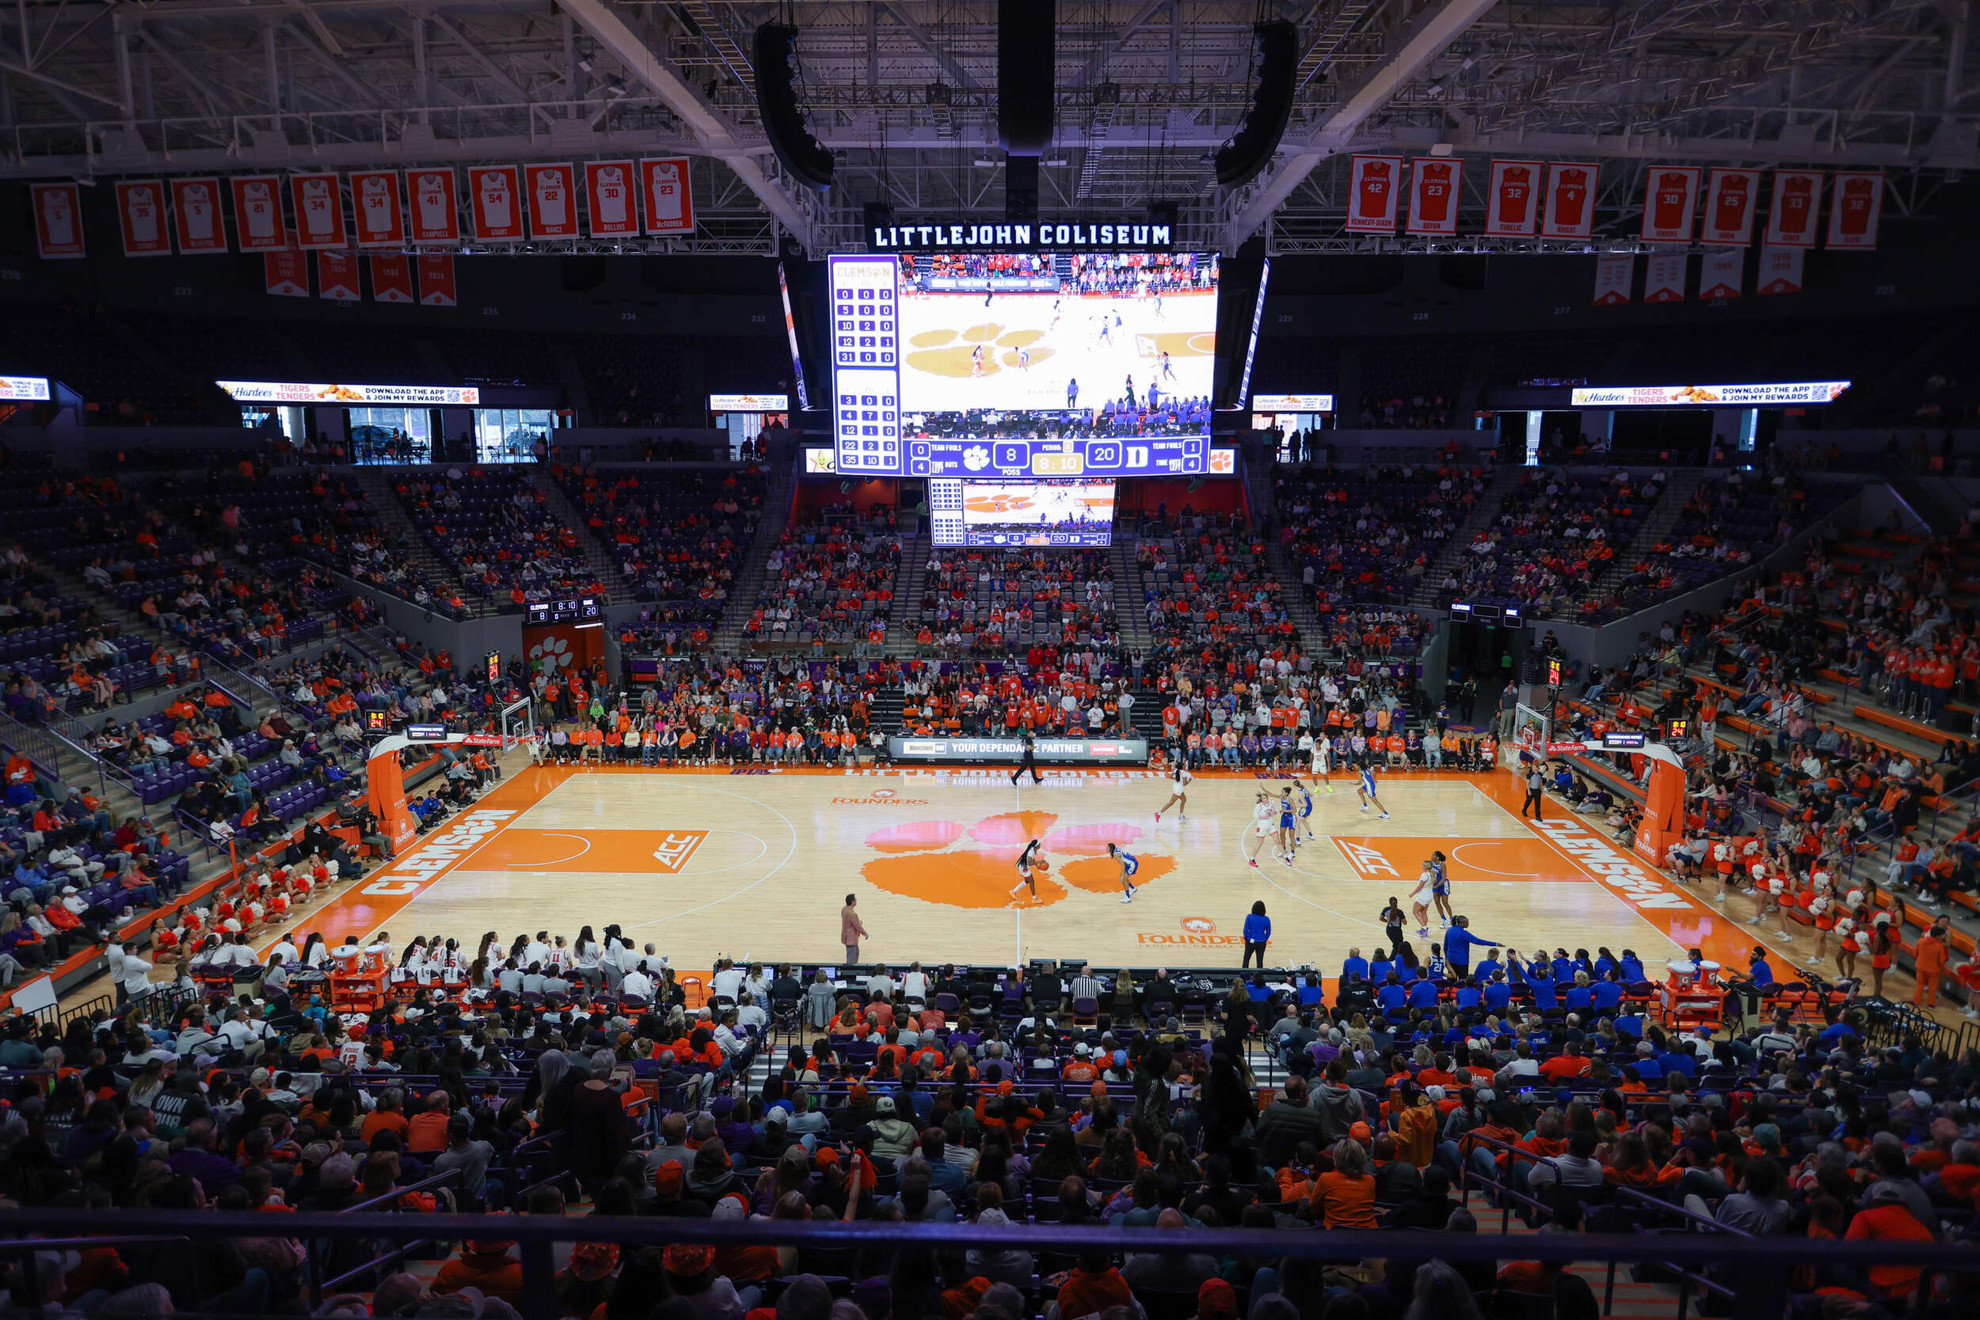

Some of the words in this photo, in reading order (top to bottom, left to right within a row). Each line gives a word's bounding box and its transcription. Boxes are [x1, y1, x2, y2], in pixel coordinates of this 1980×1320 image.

[605, 188, 619, 198] 30
[660, 185, 673, 195] 23
[1367, 183, 1383, 193] 42
[1428, 186, 1442, 196] 23
[1507, 188, 1522, 198] 32
[426, 195, 438, 205] 41
[488, 193, 501, 203] 54
[545, 191, 558, 200] 22
[1566, 190, 1575, 200] 4
[1663, 194, 1679, 205] 30
[311, 200, 325, 211] 34
[369, 198, 383, 208] 34
[1723, 196, 1738, 207] 25
[603, 223, 626, 231] ROLLINS
[874, 225, 1031, 246] LITTLEJOHN
[1040, 225, 1170, 245] COLISEUM
[842, 291, 848, 299] 0
[863, 291, 870, 299] 0
[883, 291, 889, 299] 0
[843, 306, 849, 314] 5
[864, 306, 870, 315] 0
[883, 307, 889, 315] 0
[842, 322, 852, 330] 10
[864, 322, 870, 330] 2
[884, 322, 890, 330] 0
[843, 338, 852, 346] 12
[865, 338, 871, 346] 2
[885, 339, 890, 347] 1
[842, 353, 853, 361] 31
[865, 353, 871, 361] 0
[884, 354, 891, 362] 0
[846, 396, 852, 404] 3
[866, 397, 872, 405] 0
[885, 397, 892, 405] 0
[917, 446, 924, 455] 0
[1190, 443, 1196, 452] 1
[1006, 449, 1017, 461] 8
[1094, 448, 1114, 461] 20
[917, 462, 924, 471] 4
[1188, 460, 1195, 468] 4
[558, 601, 576, 610] 8:10
[540, 612, 545, 620] 8
[586, 607, 596, 615] 20
[489, 664, 499, 680] 24
[1549, 669, 1559, 685] 24
[370, 719, 381, 727] 24
[1671, 728, 1684, 736] 24
[952, 743, 978, 752] YOUR
[979, 743, 1040, 753] DEPENDAE
[1041, 744, 1083, 753] PARTNER
[845, 769, 1031, 778] LITTLEJOHN
[360, 809, 518, 895] CLEMSON
[652, 833, 693, 866] ACC
[1347, 842, 1400, 877] ACC
[1530, 819, 1694, 908] CLEMSON
[1137, 933, 1273, 945] FOUNDE
[552, 954, 560, 962] 11
[1434, 962, 1443, 972] 21
[343, 1054, 357, 1068] 12
[156, 1095, 188, 1114] OWN
